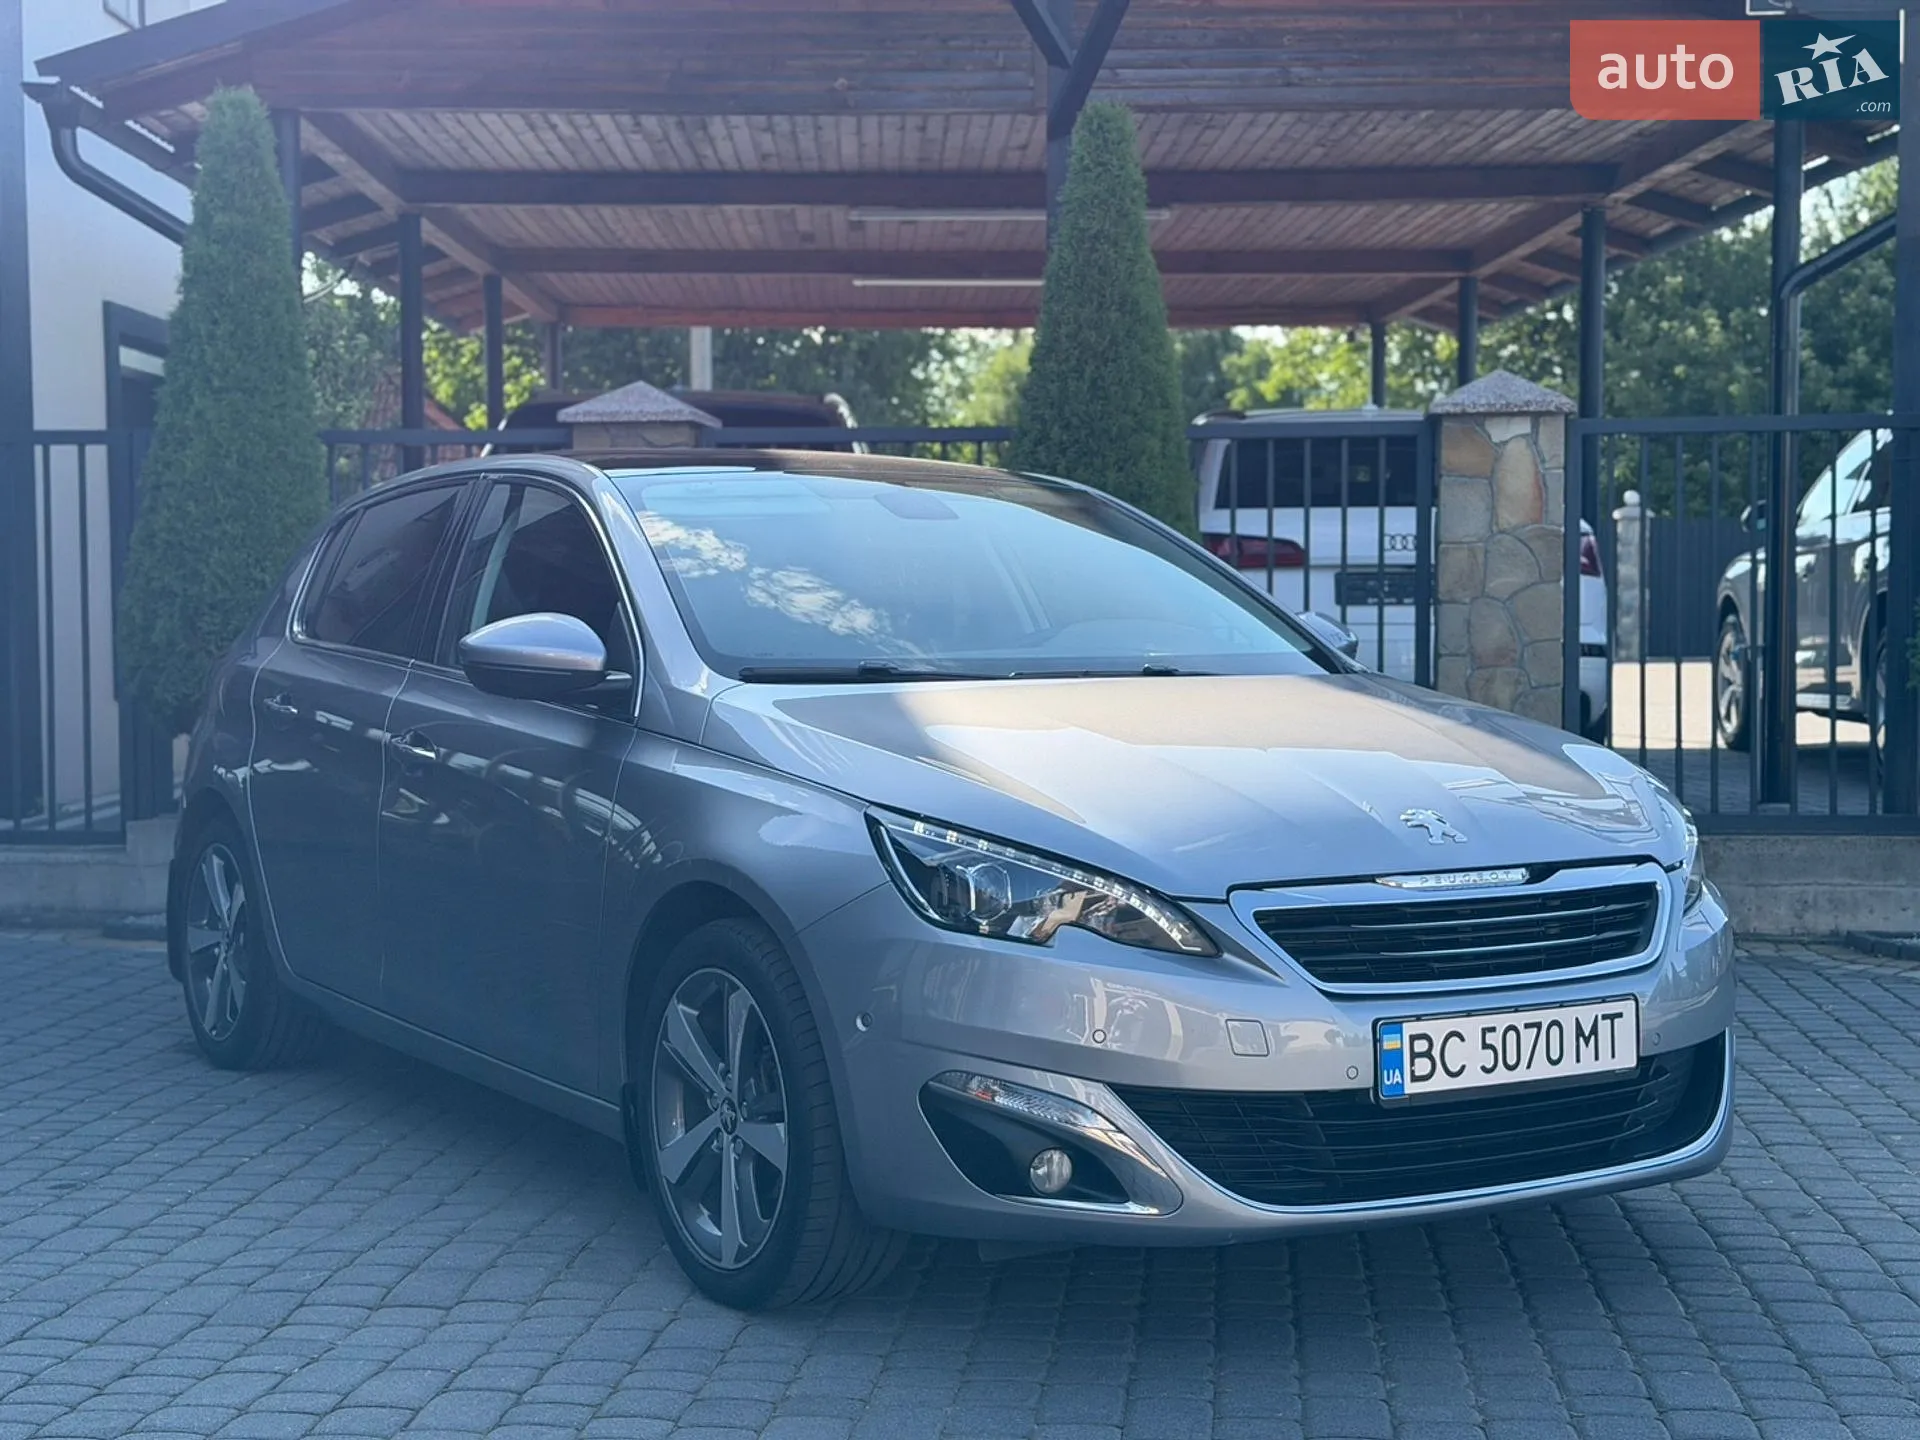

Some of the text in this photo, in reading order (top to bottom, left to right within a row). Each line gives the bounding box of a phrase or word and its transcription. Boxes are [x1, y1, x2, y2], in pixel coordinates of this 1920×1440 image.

[1419, 870, 1511, 885] PEUGEOT
[1408, 1012, 1624, 1084] BC 5070 MT
[1383, 1068, 1403, 1085] UA
